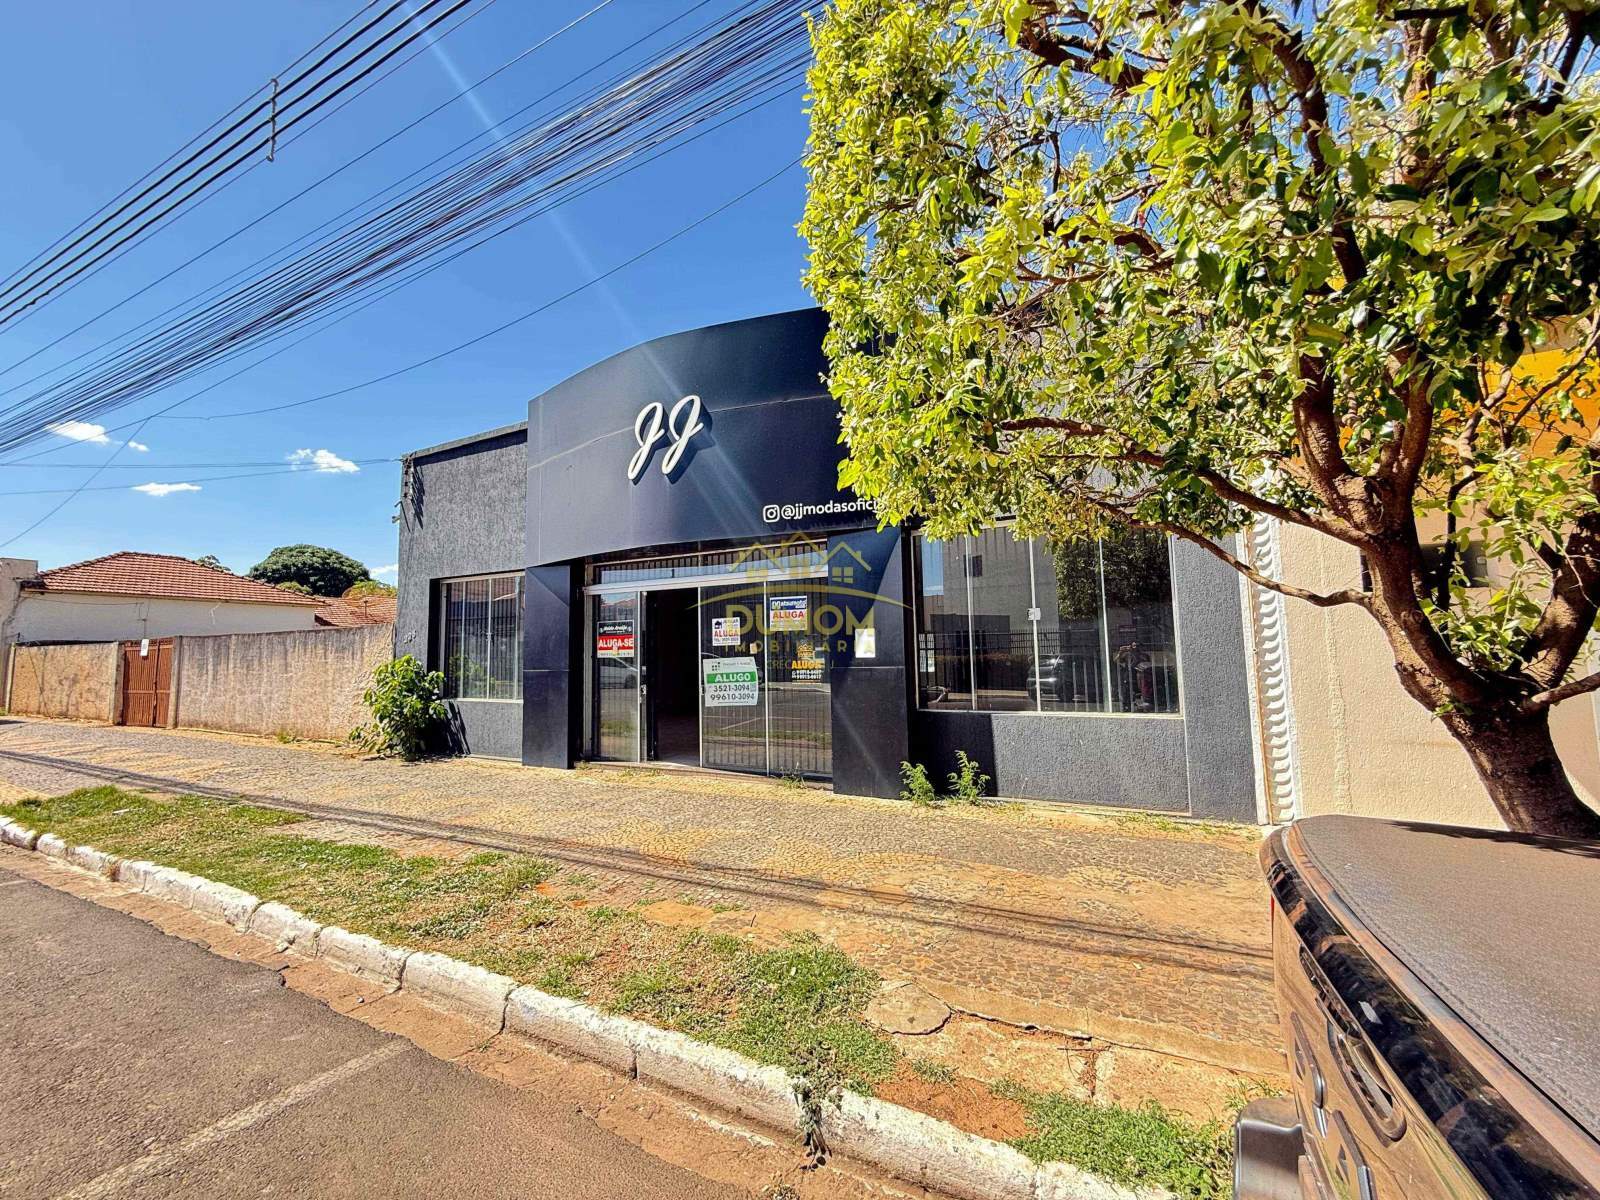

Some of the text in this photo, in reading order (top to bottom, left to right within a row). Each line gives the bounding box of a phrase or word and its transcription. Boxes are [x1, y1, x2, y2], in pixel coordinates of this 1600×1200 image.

[773, 610, 804, 619] ALUGA
[714, 629, 739, 637] ALUGA
[598, 638, 633, 648] ALUGA-SE
[715, 673, 751, 682] ALUGO
[713, 684, 750, 692] 3521-3094
